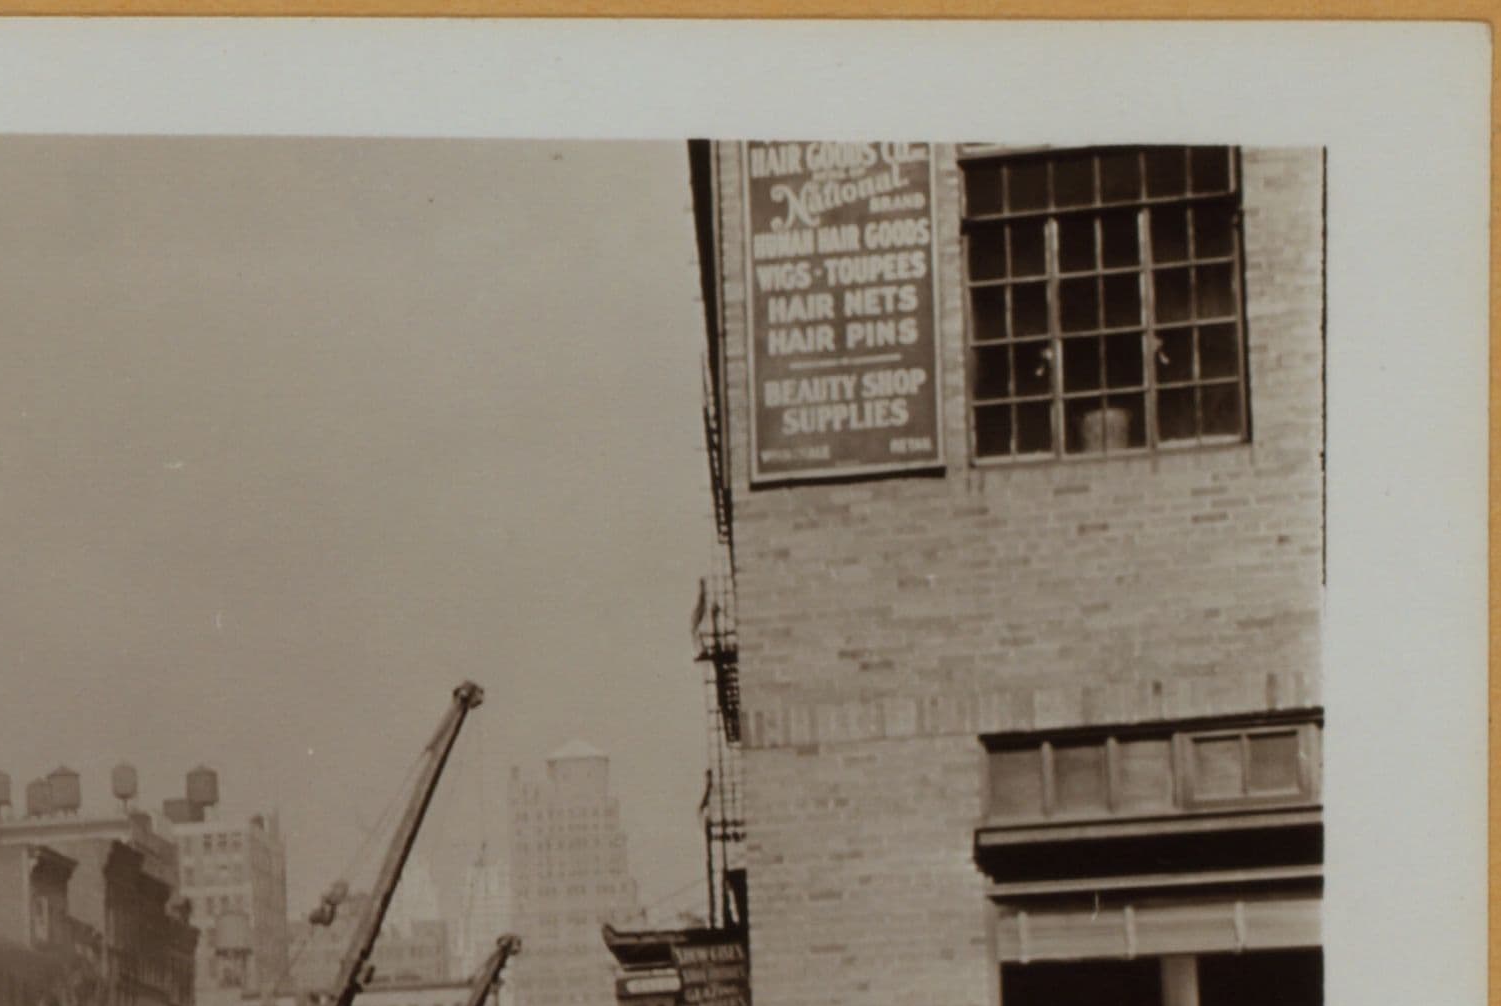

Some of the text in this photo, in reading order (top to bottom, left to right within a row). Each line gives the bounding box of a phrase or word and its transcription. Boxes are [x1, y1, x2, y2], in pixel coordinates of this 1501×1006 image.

[750, 145, 803, 178] HAIR
[770, 163, 909, 231] National
[753, 218, 930, 259] HUMAN HAIR GOODS
[756, 250, 927, 292] WIGS TOUPEES
[767, 285, 918, 325] HAIR NETS
[767, 317, 919, 357] HAIR PINS
[764, 367, 927, 408] BEAUTY SHOP
[782, 398, 910, 435] SUPPLIES
